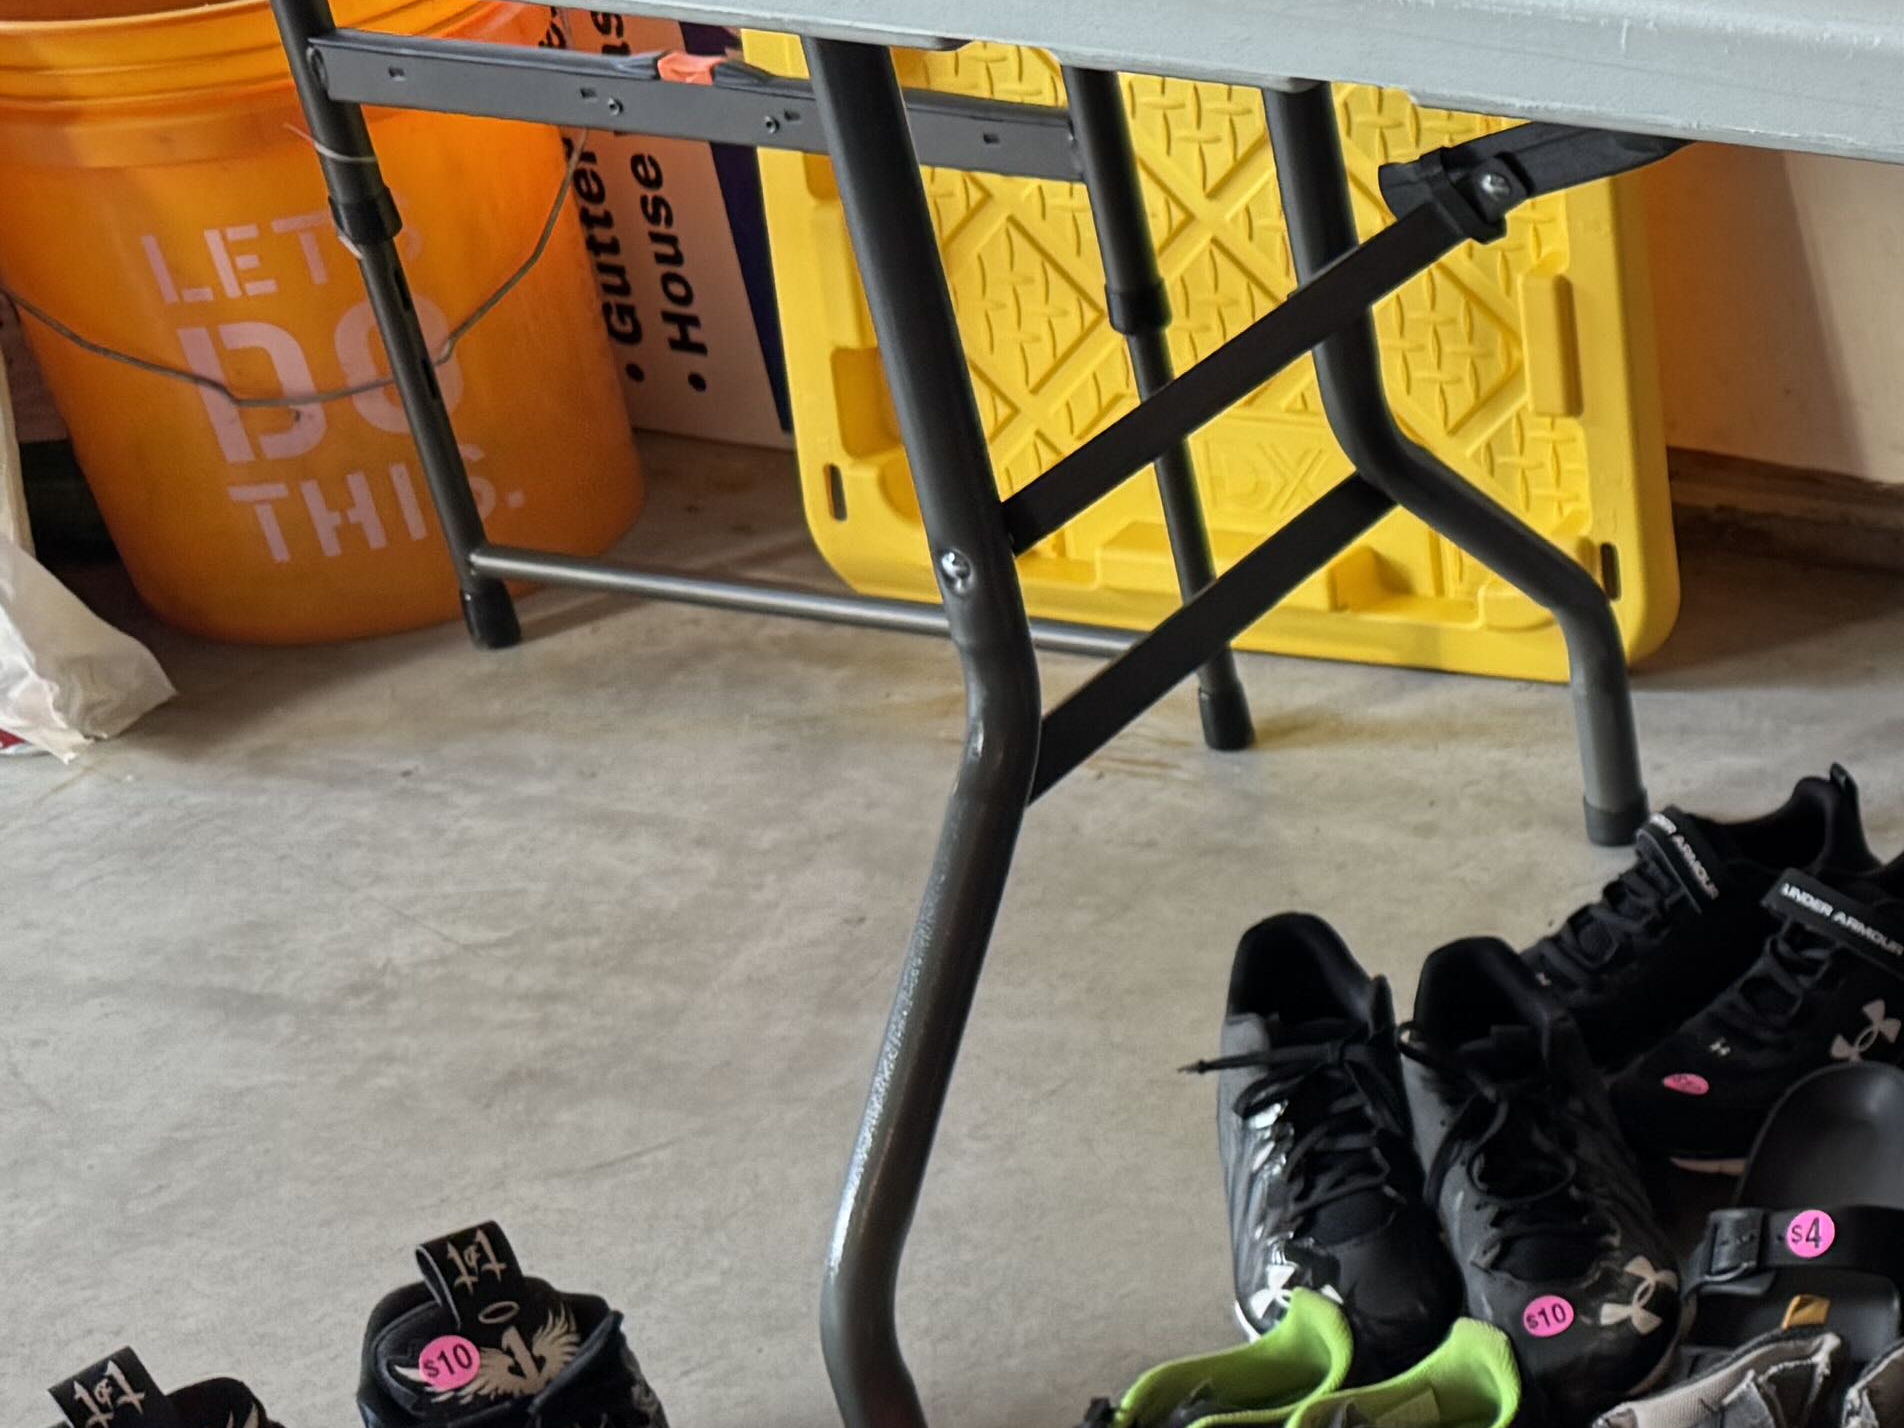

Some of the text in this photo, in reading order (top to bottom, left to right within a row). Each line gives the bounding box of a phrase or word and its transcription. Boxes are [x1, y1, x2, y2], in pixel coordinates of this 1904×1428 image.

[630, 152, 709, 357] House
[176, 298, 465, 464] DO
[1780, 881, 1904, 957] UNDER ARMOUR
[1790, 1216, 1823, 1250] $4
[1525, 1302, 1567, 1330] $10
[423, 1342, 474, 1378] $10
